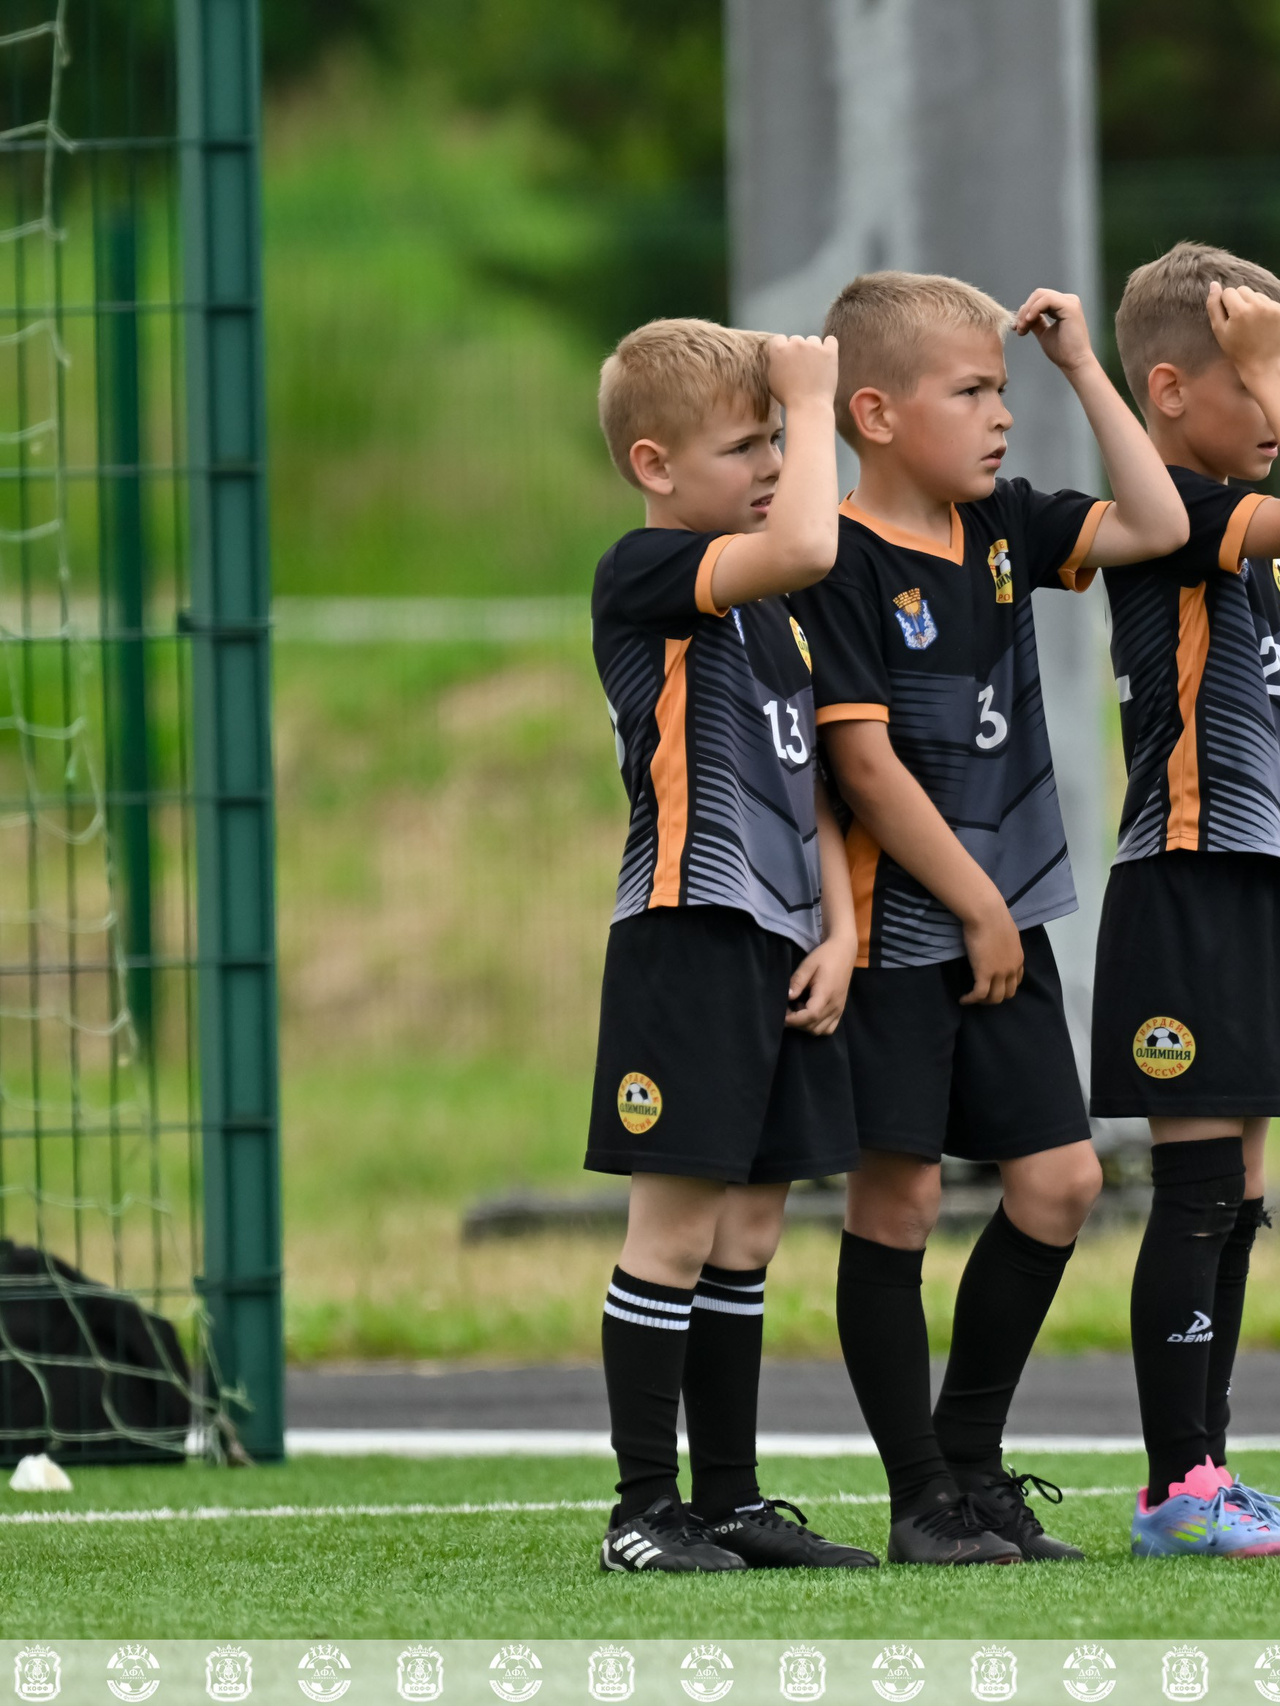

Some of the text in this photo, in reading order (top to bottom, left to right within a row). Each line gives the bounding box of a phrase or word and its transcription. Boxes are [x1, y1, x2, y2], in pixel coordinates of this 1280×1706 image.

[976, 684, 1008, 749] 3
[763, 700, 808, 765] 13
[1136, 1047, 1191, 1061] ОЛИМПИЯ
[1140, 1062, 1185, 1077] РОССИЯ
[714, 1520, 744, 1535] OPA
